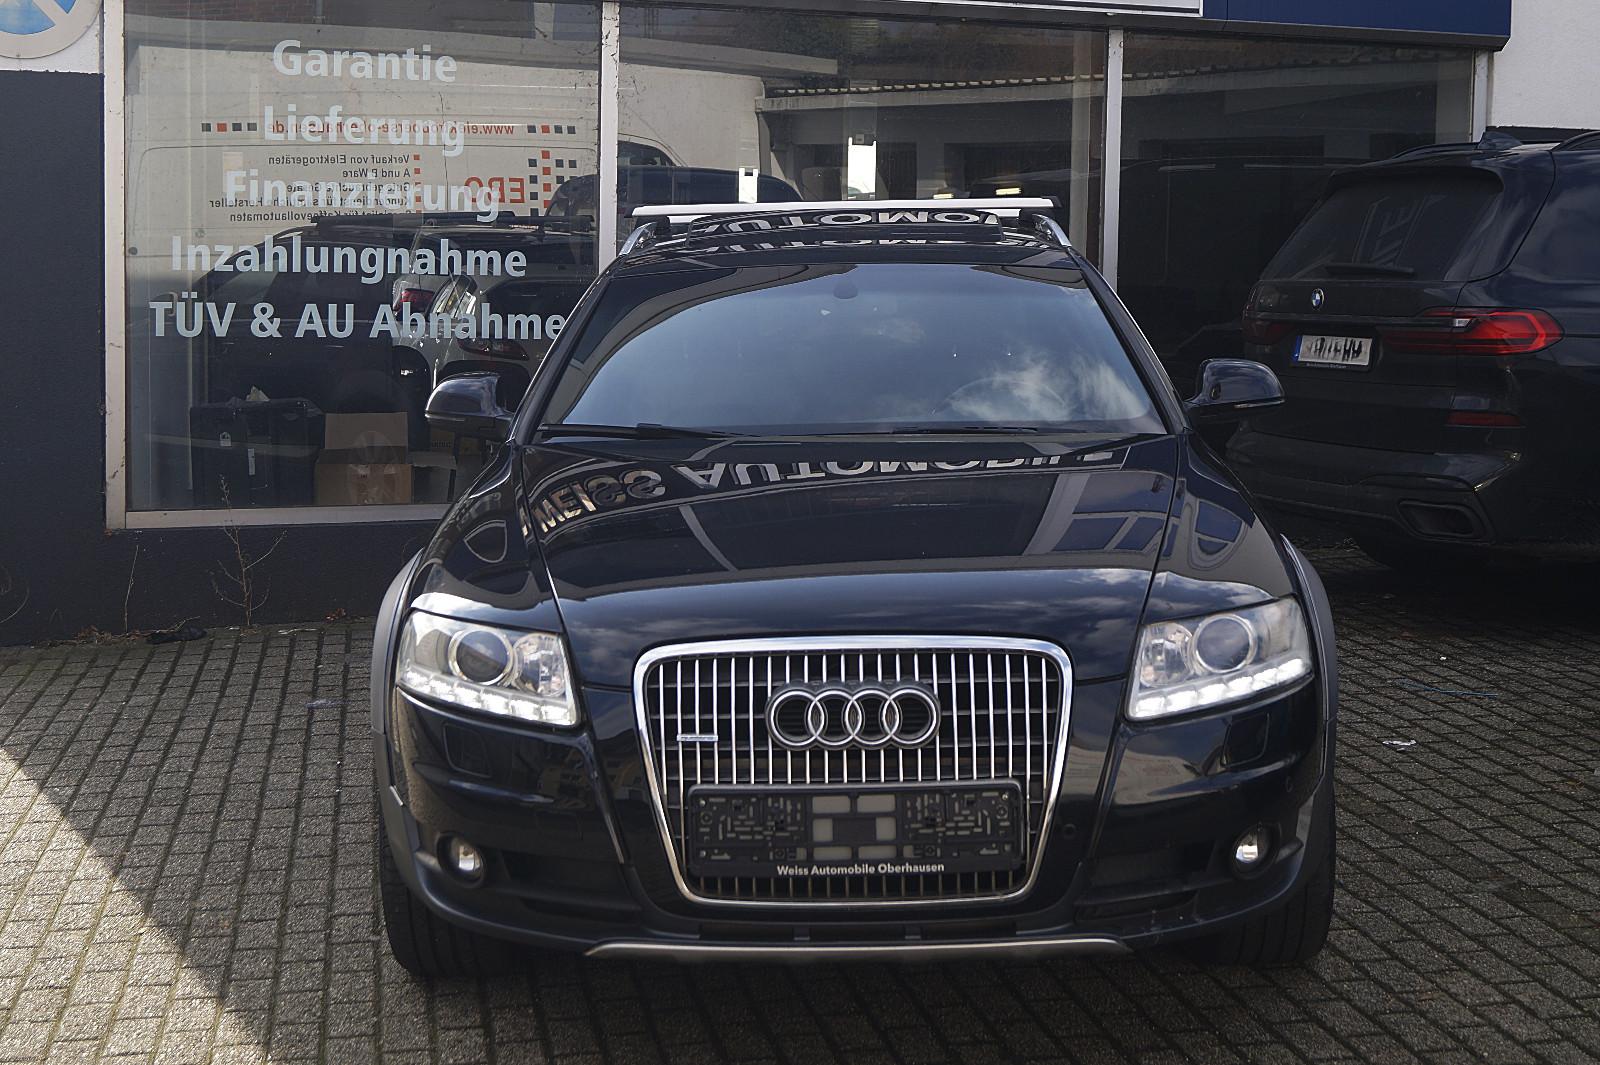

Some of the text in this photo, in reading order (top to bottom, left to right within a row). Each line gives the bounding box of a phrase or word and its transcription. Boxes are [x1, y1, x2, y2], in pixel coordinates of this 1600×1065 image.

[272, 39, 458, 82] Garantie
[264, 104, 465, 157] Lieferung
[224, 168, 499, 222] Finanzierung
[171, 235, 528, 285] Inzahlungnahme
[149, 291, 566, 340] TÜV & AU Abnahme
[776, 863, 945, 876] Weiss Automobile Oberhausen
